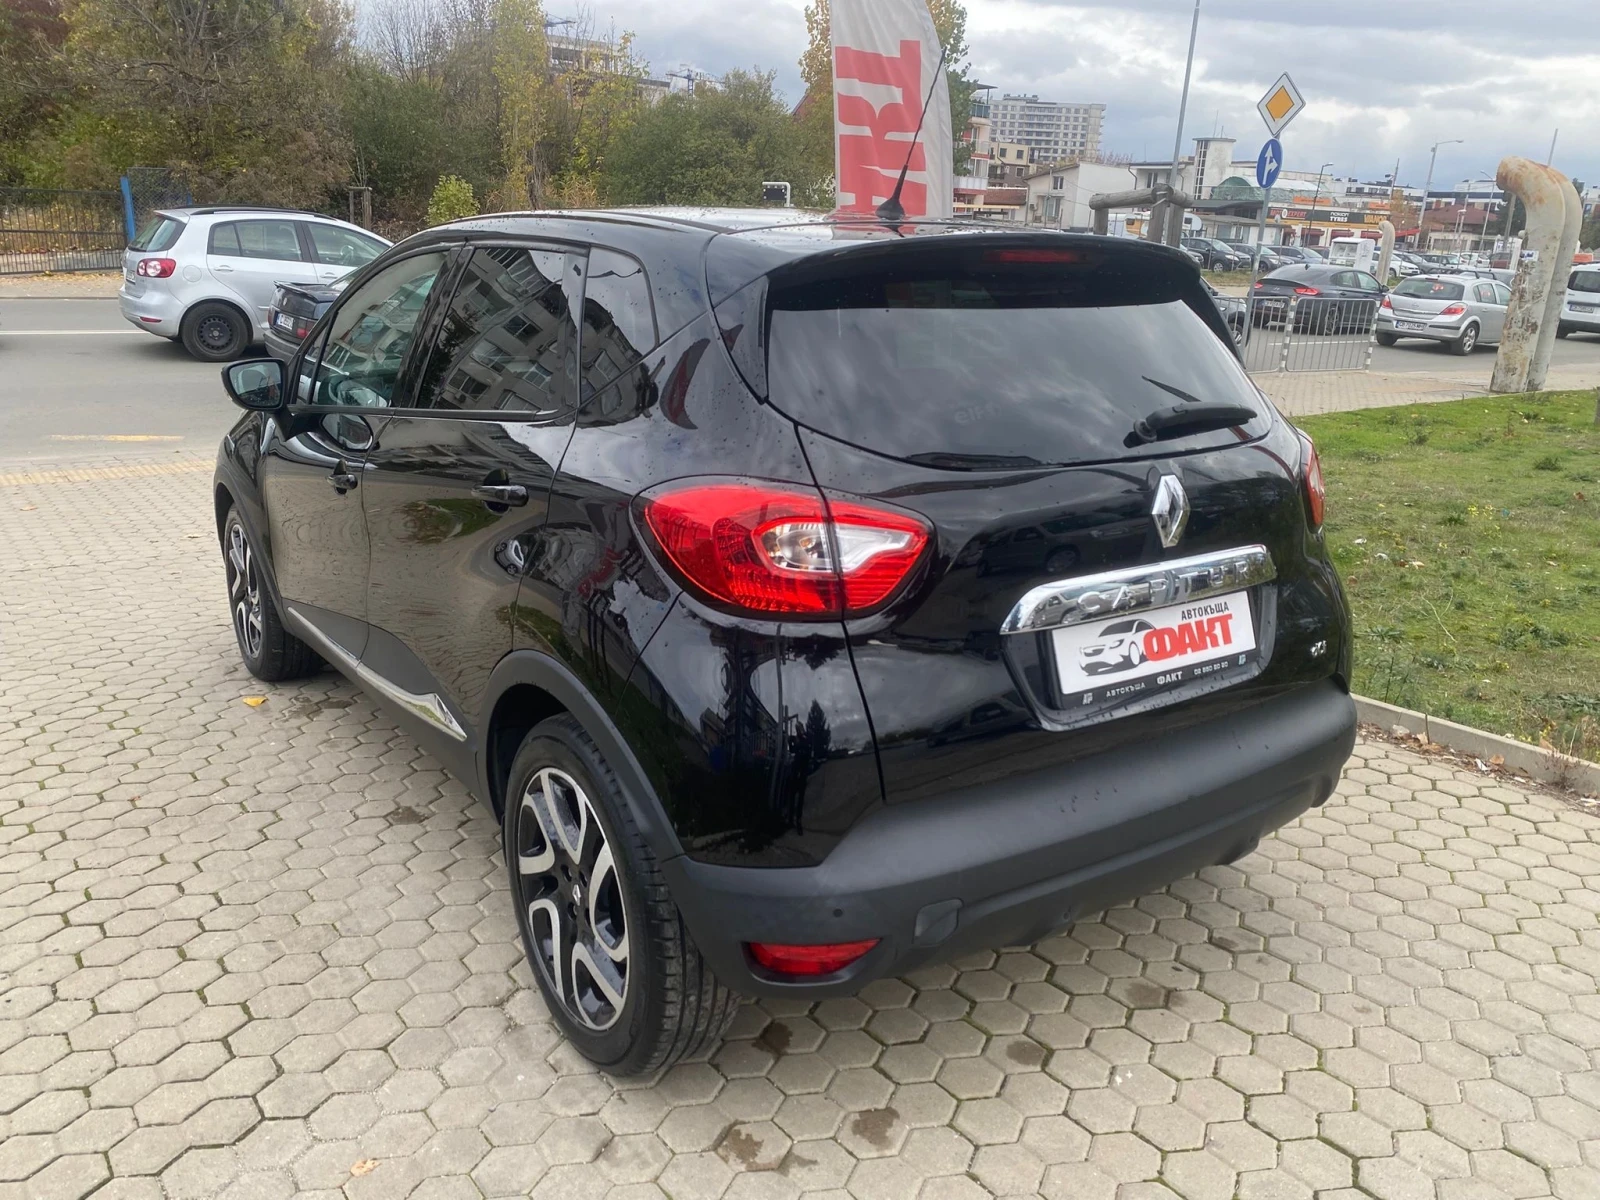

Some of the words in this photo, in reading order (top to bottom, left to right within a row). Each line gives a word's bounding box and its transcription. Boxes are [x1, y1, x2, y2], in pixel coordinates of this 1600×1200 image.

[1077, 561, 1248, 612] CAPTUR
[1181, 601, 1230, 621] АВТОКЪЩА
[1143, 613, 1233, 662] ФАКТ
[1156, 671, 1183, 685] ФАКТ
